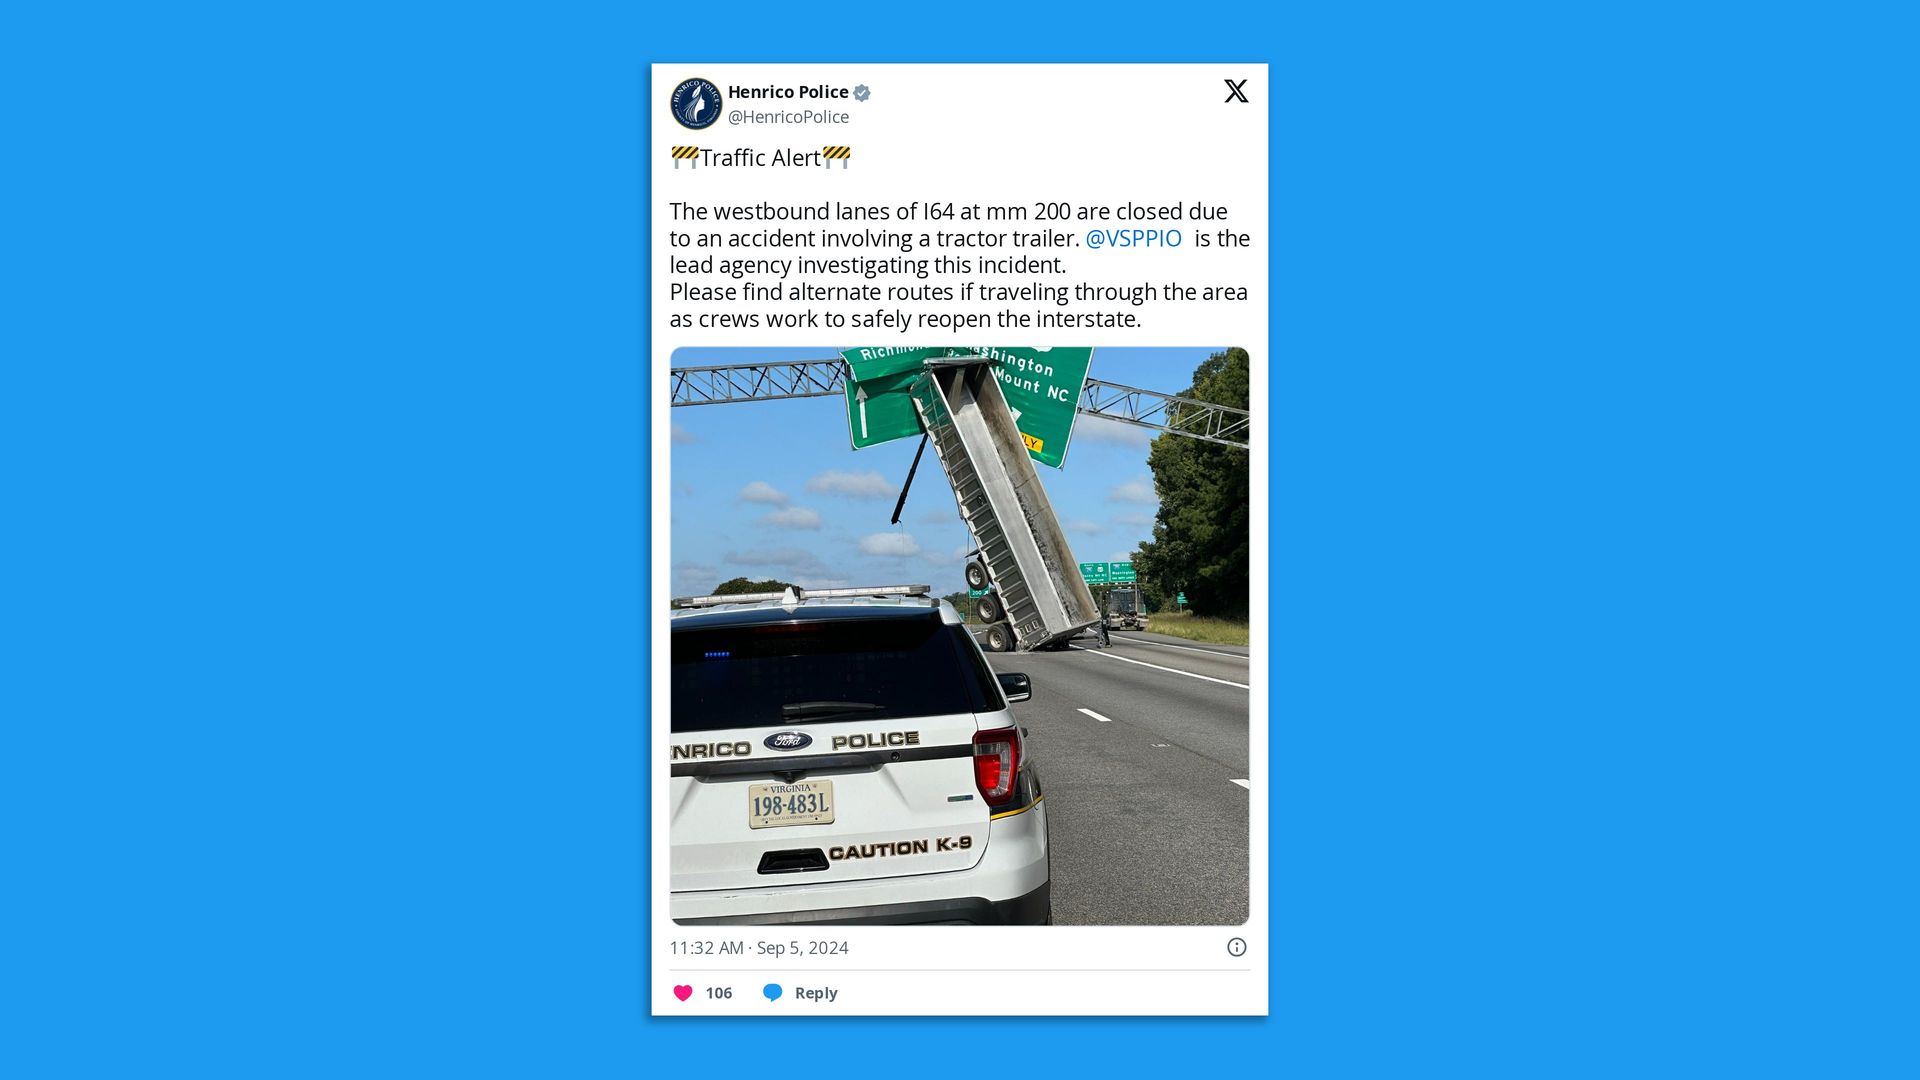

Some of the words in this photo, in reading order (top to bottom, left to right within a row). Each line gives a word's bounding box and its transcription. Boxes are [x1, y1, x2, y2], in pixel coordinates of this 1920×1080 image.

[966, 346, 1053, 377] ashington
[995, 366, 1040, 393] Mount
[1047, 384, 1070, 402] NC
[670, 740, 752, 760] NRICO
[774, 734, 801, 746] Ford
[831, 731, 920, 750] POLICE
[770, 784, 811, 794] VIRGINIA
[754, 793, 829, 817] 198-483L
[829, 840, 929, 861] CAUTION
[936, 835, 972, 851] K-9
